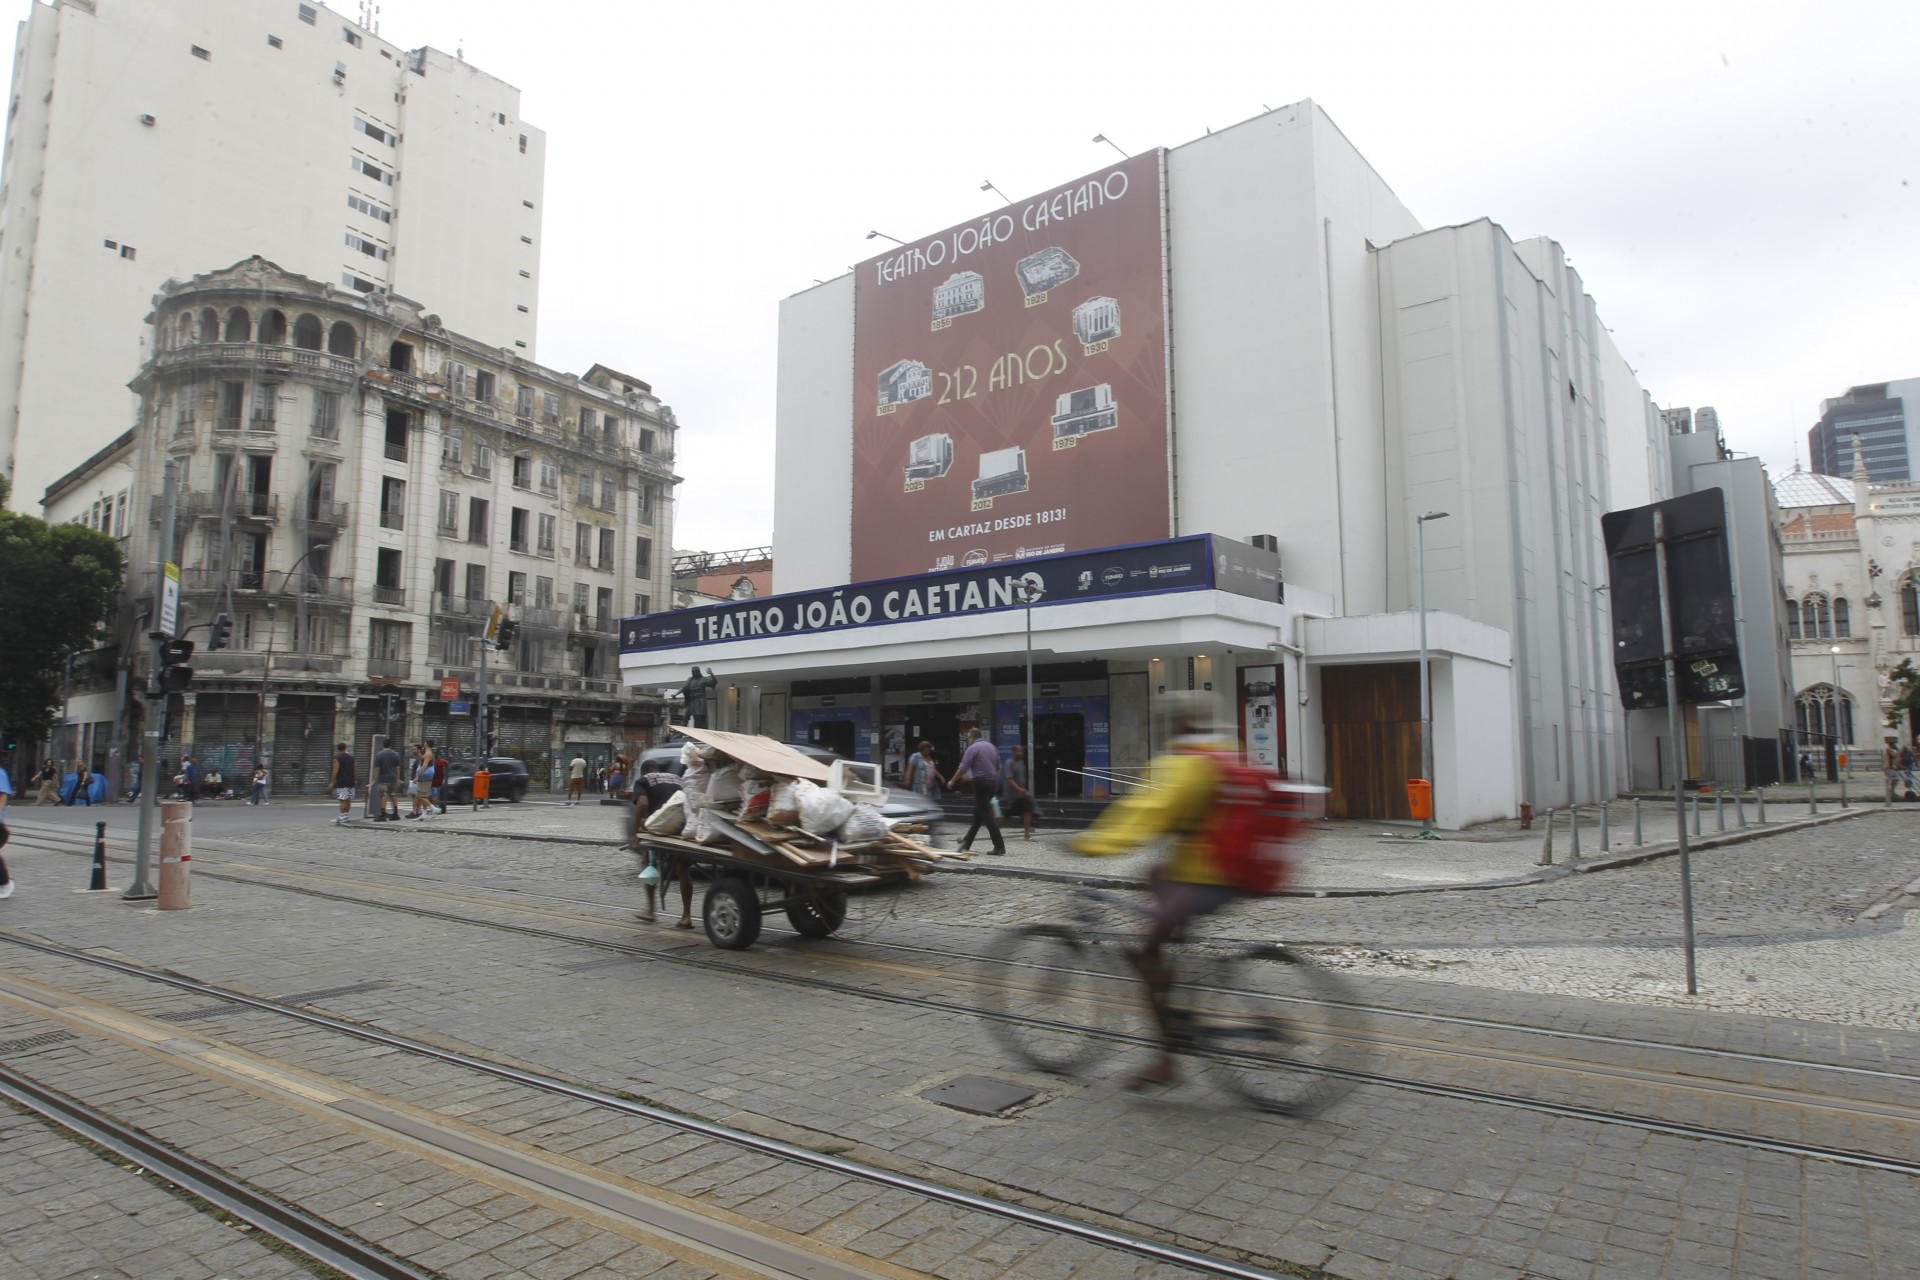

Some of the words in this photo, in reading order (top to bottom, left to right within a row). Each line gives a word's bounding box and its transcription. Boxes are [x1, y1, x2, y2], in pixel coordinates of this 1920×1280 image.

[876, 240, 946, 286] TEATRO
[951, 214, 1014, 264] JOÃO
[1022, 170, 1129, 232] CAETANO
[1026, 293, 1047, 307] 1928
[932, 317, 951, 331] 1856
[1085, 341, 1107, 355] 1930
[937, 364, 978, 405] 212
[989, 338, 1067, 393] ANOS
[878, 404, 895, 415] 1813
[1054, 436, 1075, 450] 1979
[904, 480, 924, 492] 2025
[972, 499, 992, 511] 2012
[928, 528, 945, 542] EM
[948, 520, 992, 539] CARTAZ
[995, 513, 1032, 531] DESDE
[1036, 507, 1066, 524] 1813!
[695, 606, 784, 641] TEATRO
[793, 589, 872, 630] JOÃO
[883, 571, 1045, 620] CAETANO
